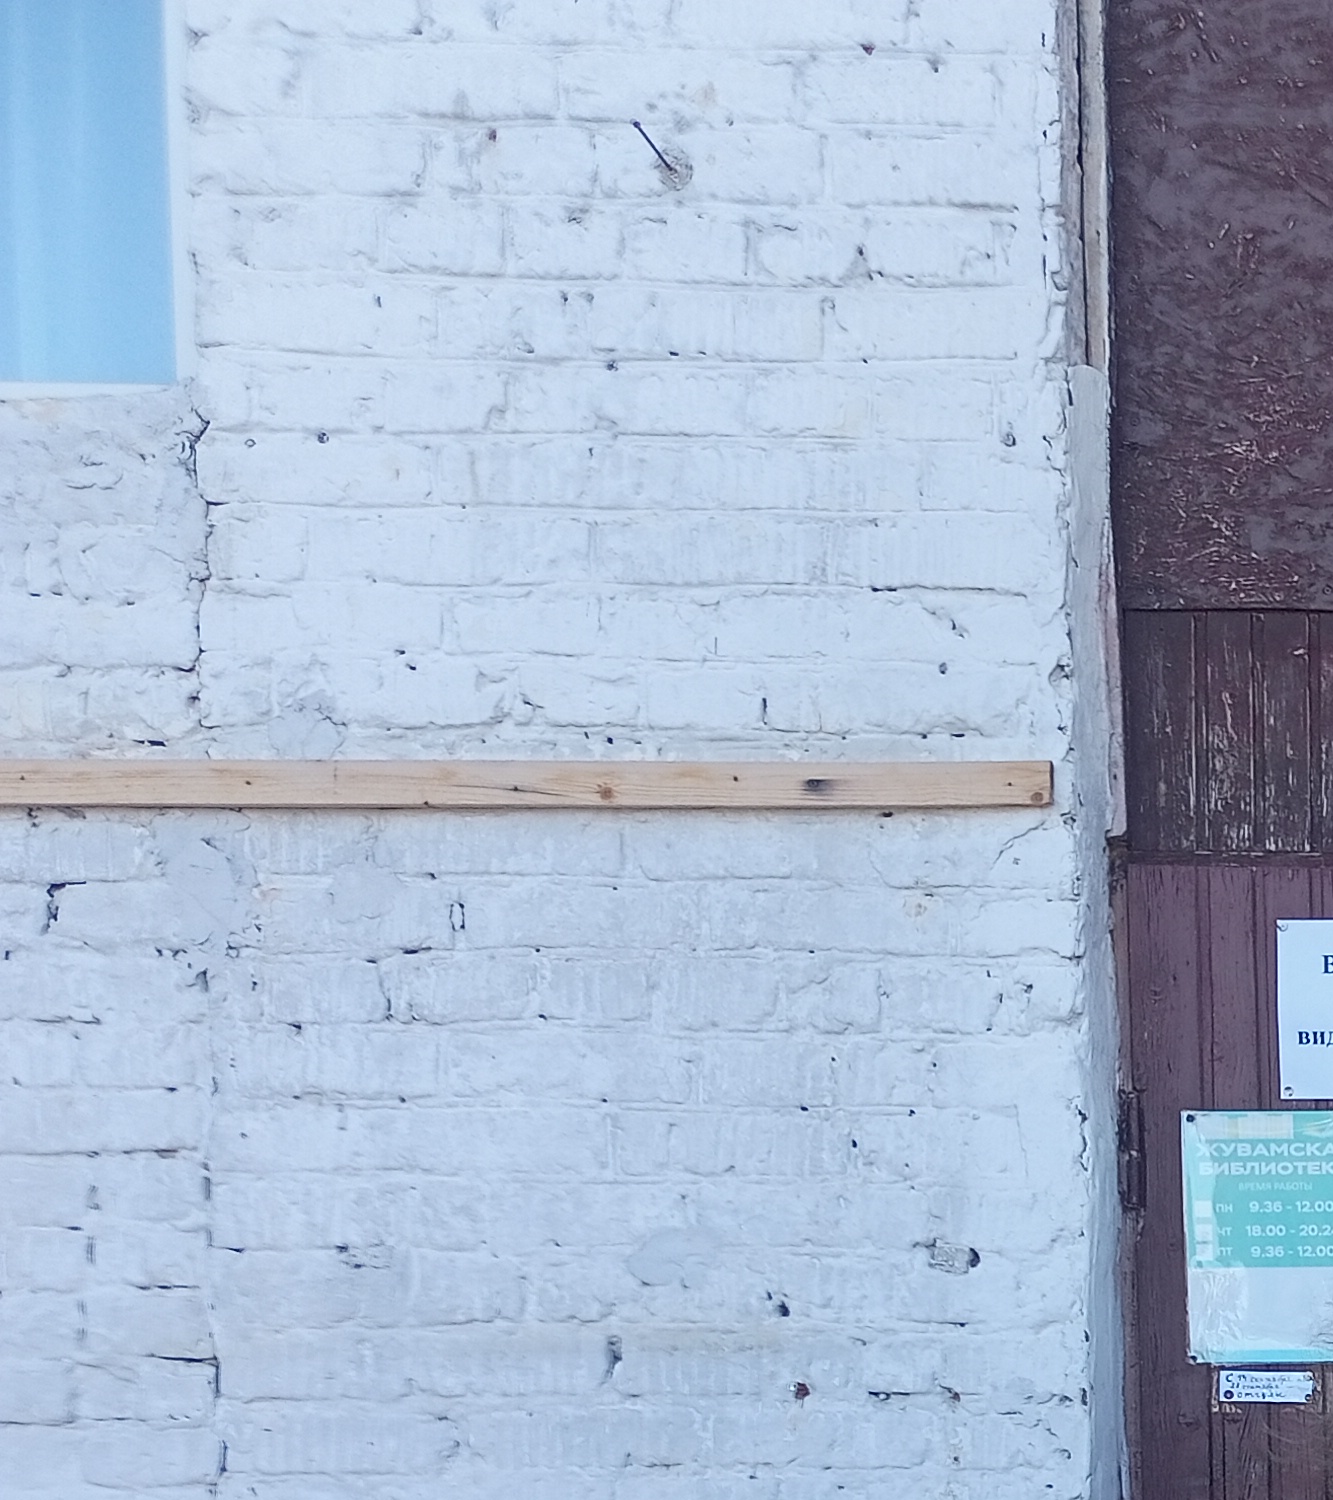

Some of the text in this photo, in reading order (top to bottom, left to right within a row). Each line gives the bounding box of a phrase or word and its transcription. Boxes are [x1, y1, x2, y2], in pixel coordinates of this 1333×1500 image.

[1238, 1182, 1313, 1191] ВРЕМЯ РАБОТЫ
[1249, 1201, 1283, 1213] 9.36
[1245, 1224, 1286, 1236] 18.00
[1251, 1245, 1285, 1257] 9.36
